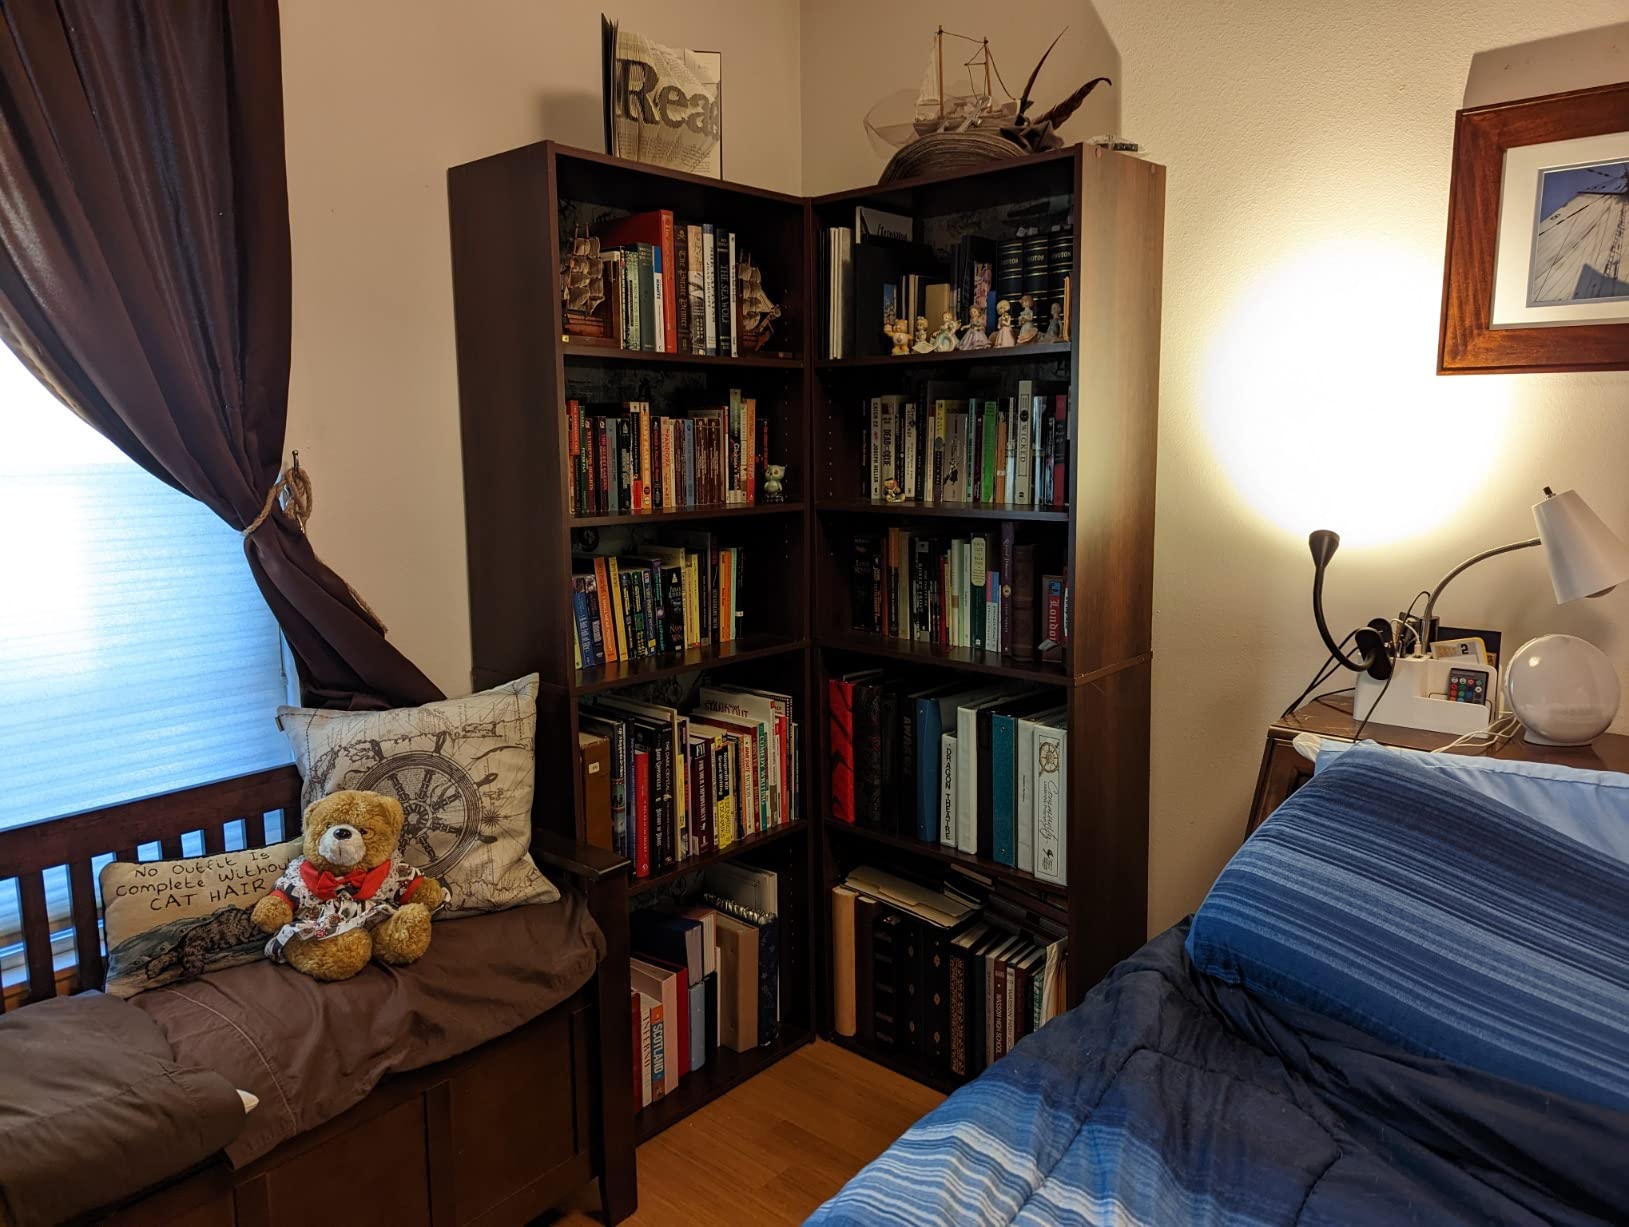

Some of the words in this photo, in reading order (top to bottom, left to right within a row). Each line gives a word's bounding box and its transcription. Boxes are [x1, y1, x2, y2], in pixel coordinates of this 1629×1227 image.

[720, 264, 728, 281] THE
[721, 283, 729, 300] SEA
[722, 301, 730, 325] WOLF
[1460, 644, 1469, 654] 2
[134, 866, 158, 878] No
[172, 856, 237, 875] Outfit
[251, 852, 270, 862] Is
[116, 876, 205, 898] Complete
[218, 858, 292, 882] Withou
[150, 894, 198, 911] CAT
[210, 878, 266, 902] HAIR
[652, 1023, 664, 1074] SCOTLAND
